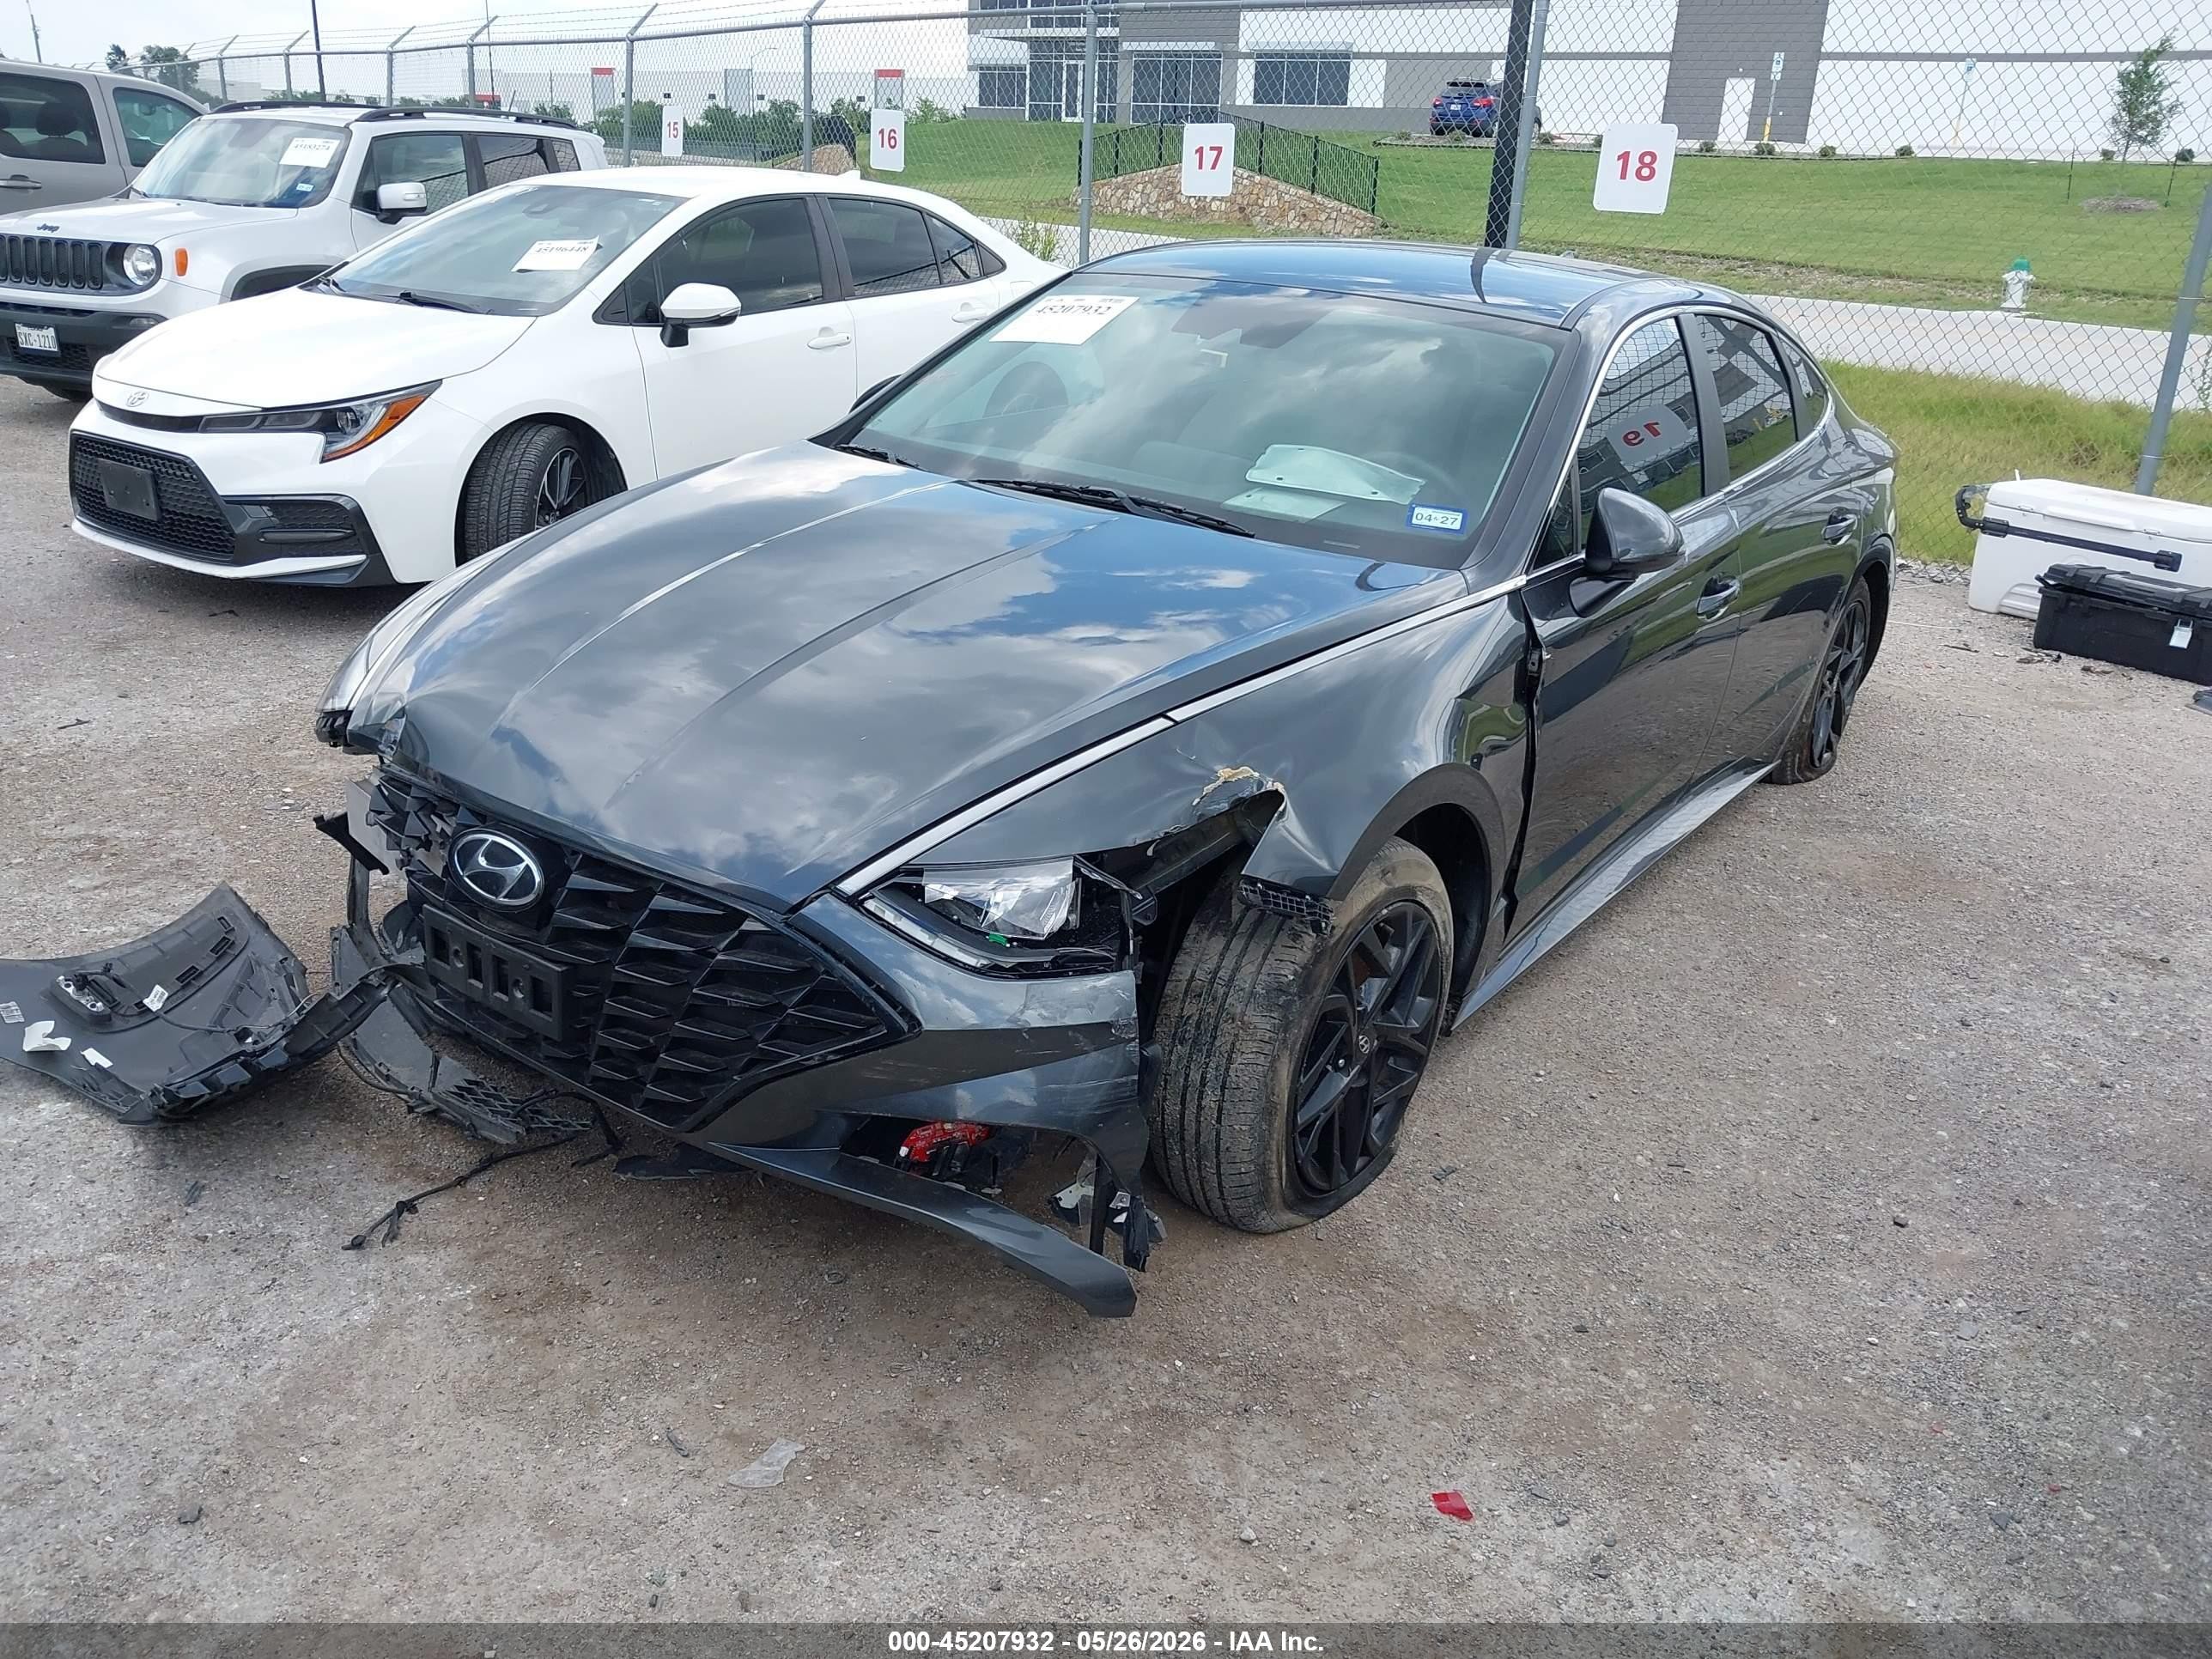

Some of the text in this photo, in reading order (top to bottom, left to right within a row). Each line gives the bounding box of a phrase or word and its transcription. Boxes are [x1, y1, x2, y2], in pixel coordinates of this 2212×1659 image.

[666, 121, 679, 139] 15
[878, 128, 898, 149] 16
[1194, 145, 1224, 170] 17
[1616, 150, 1658, 182] 18
[1036, 304, 1112, 315] 45207932
